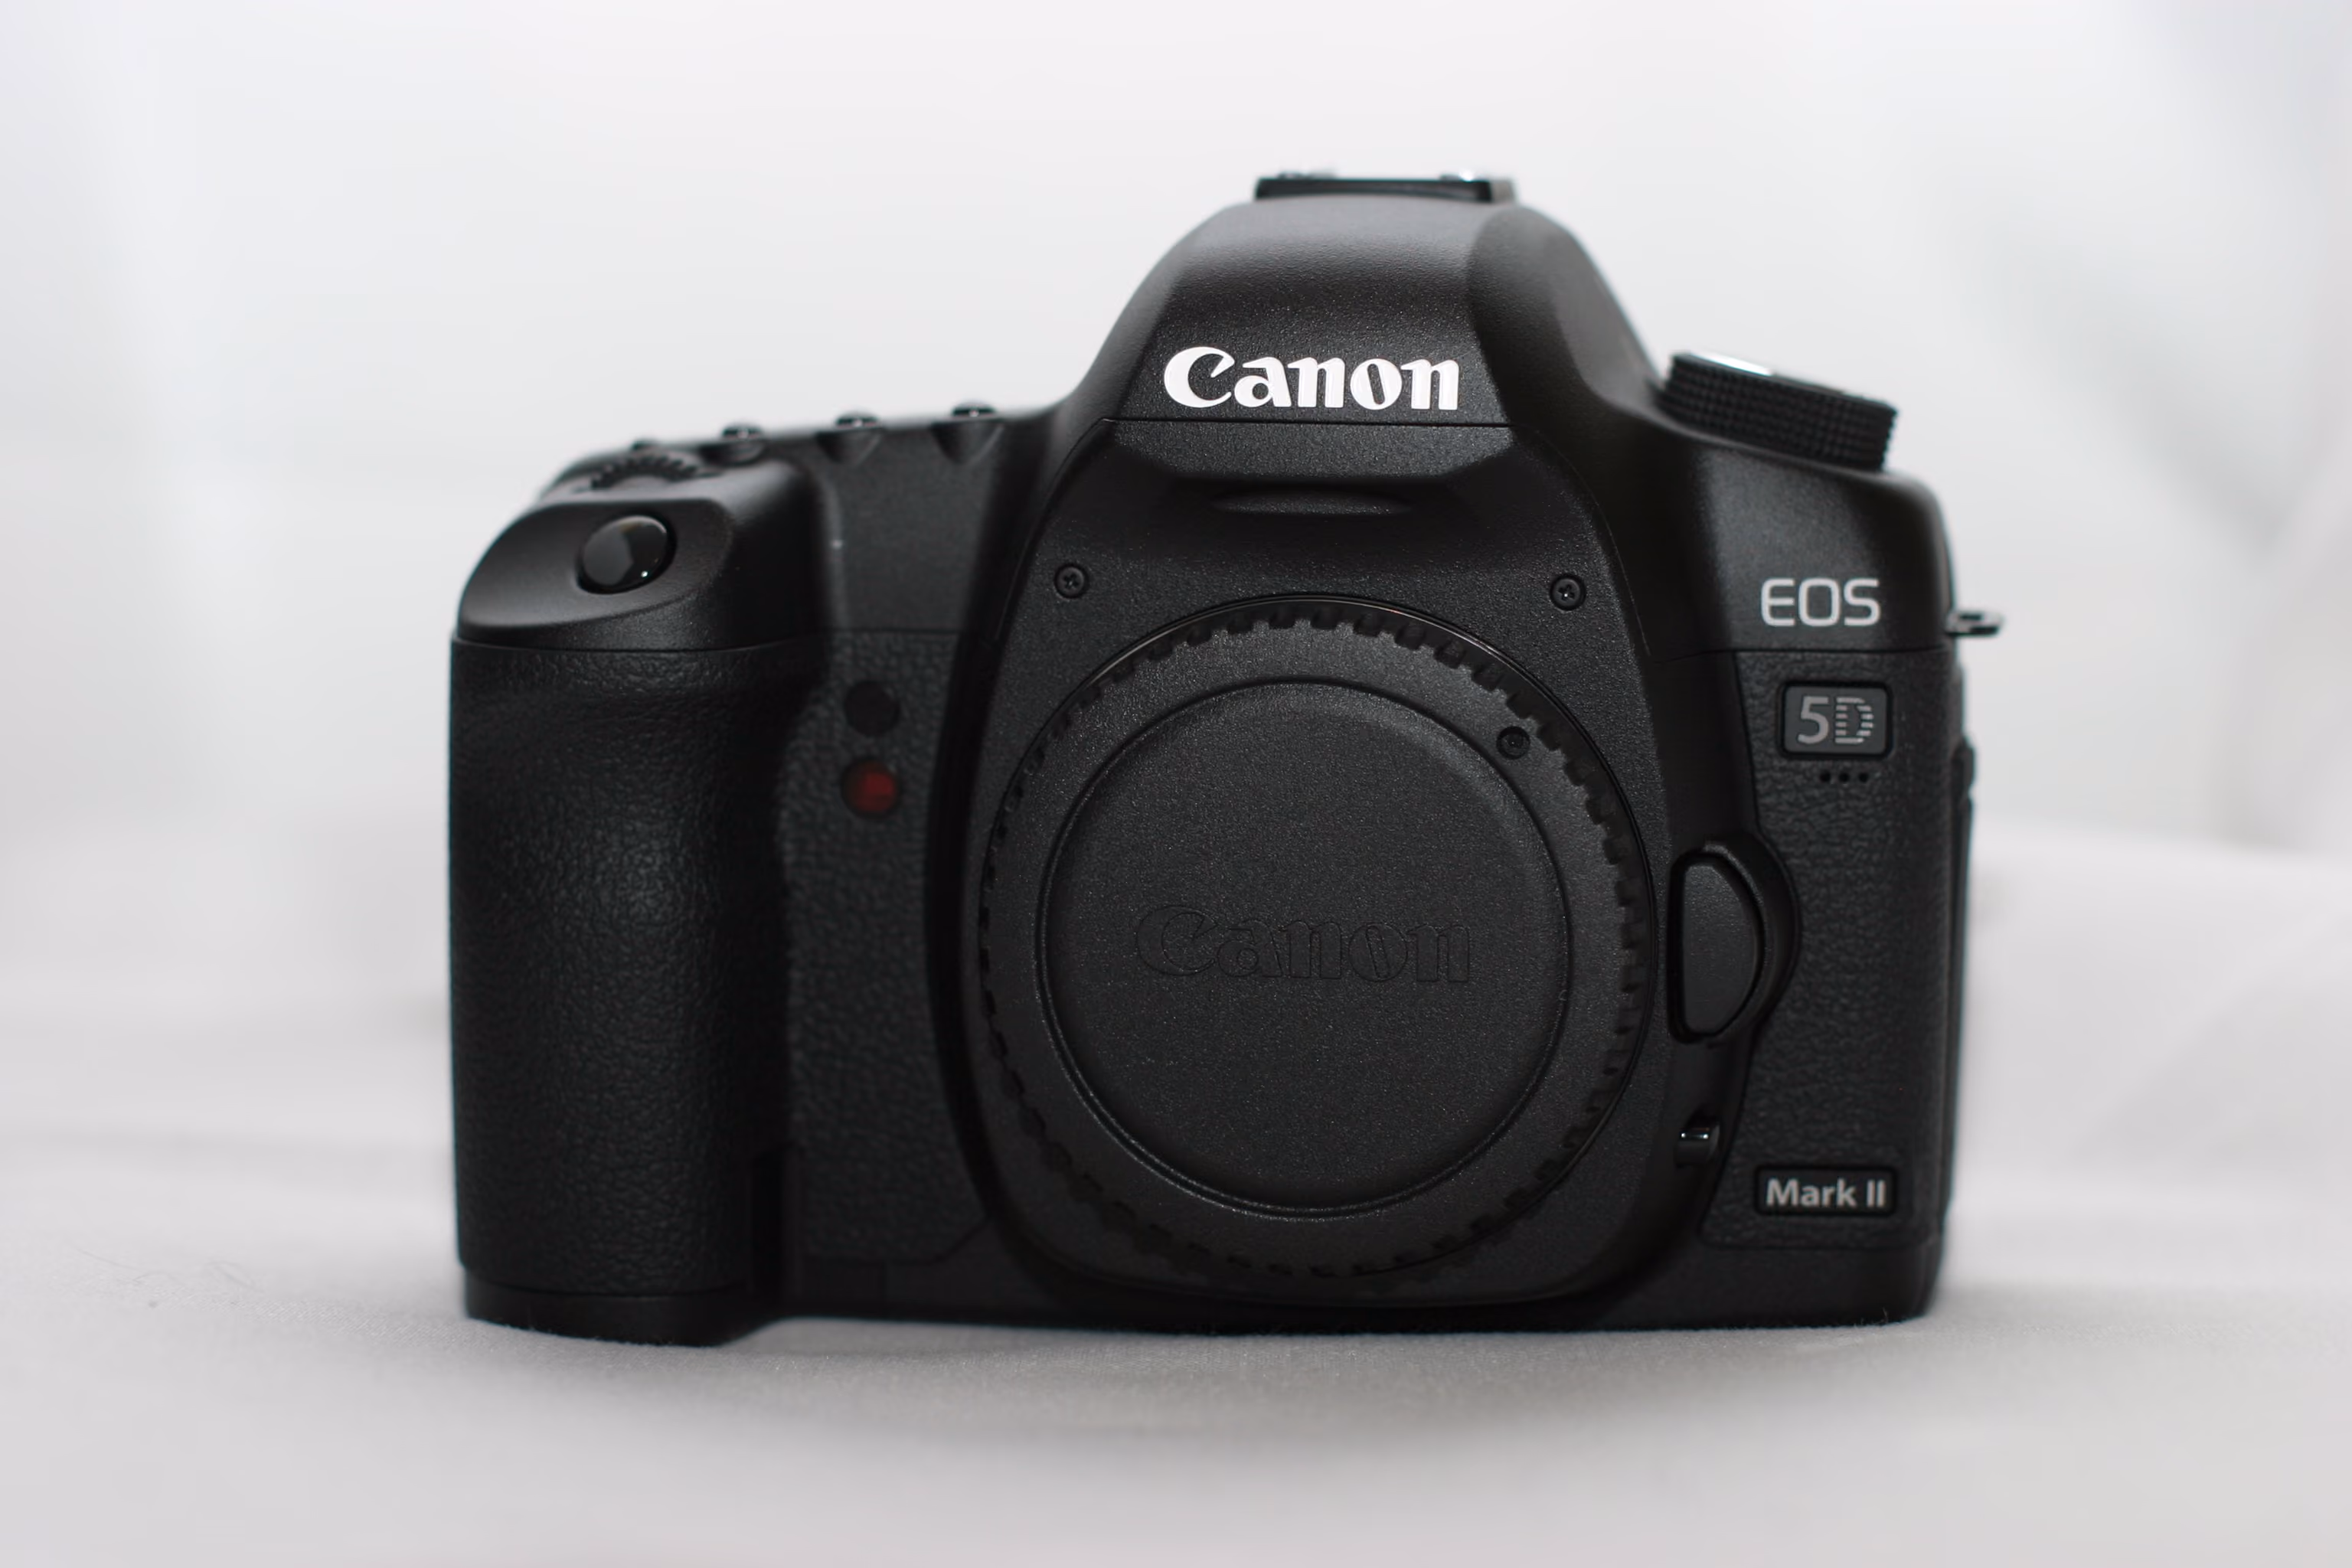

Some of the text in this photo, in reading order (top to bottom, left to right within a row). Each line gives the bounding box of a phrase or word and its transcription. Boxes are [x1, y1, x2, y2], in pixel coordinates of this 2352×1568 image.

[1163, 345, 1460, 411] Canon
[1760, 577, 1881, 627] EOS
[1797, 695, 1874, 744] 5D
[1135, 905, 1471, 983] Canon
[1766, 1178, 1887, 1207] Mark II
